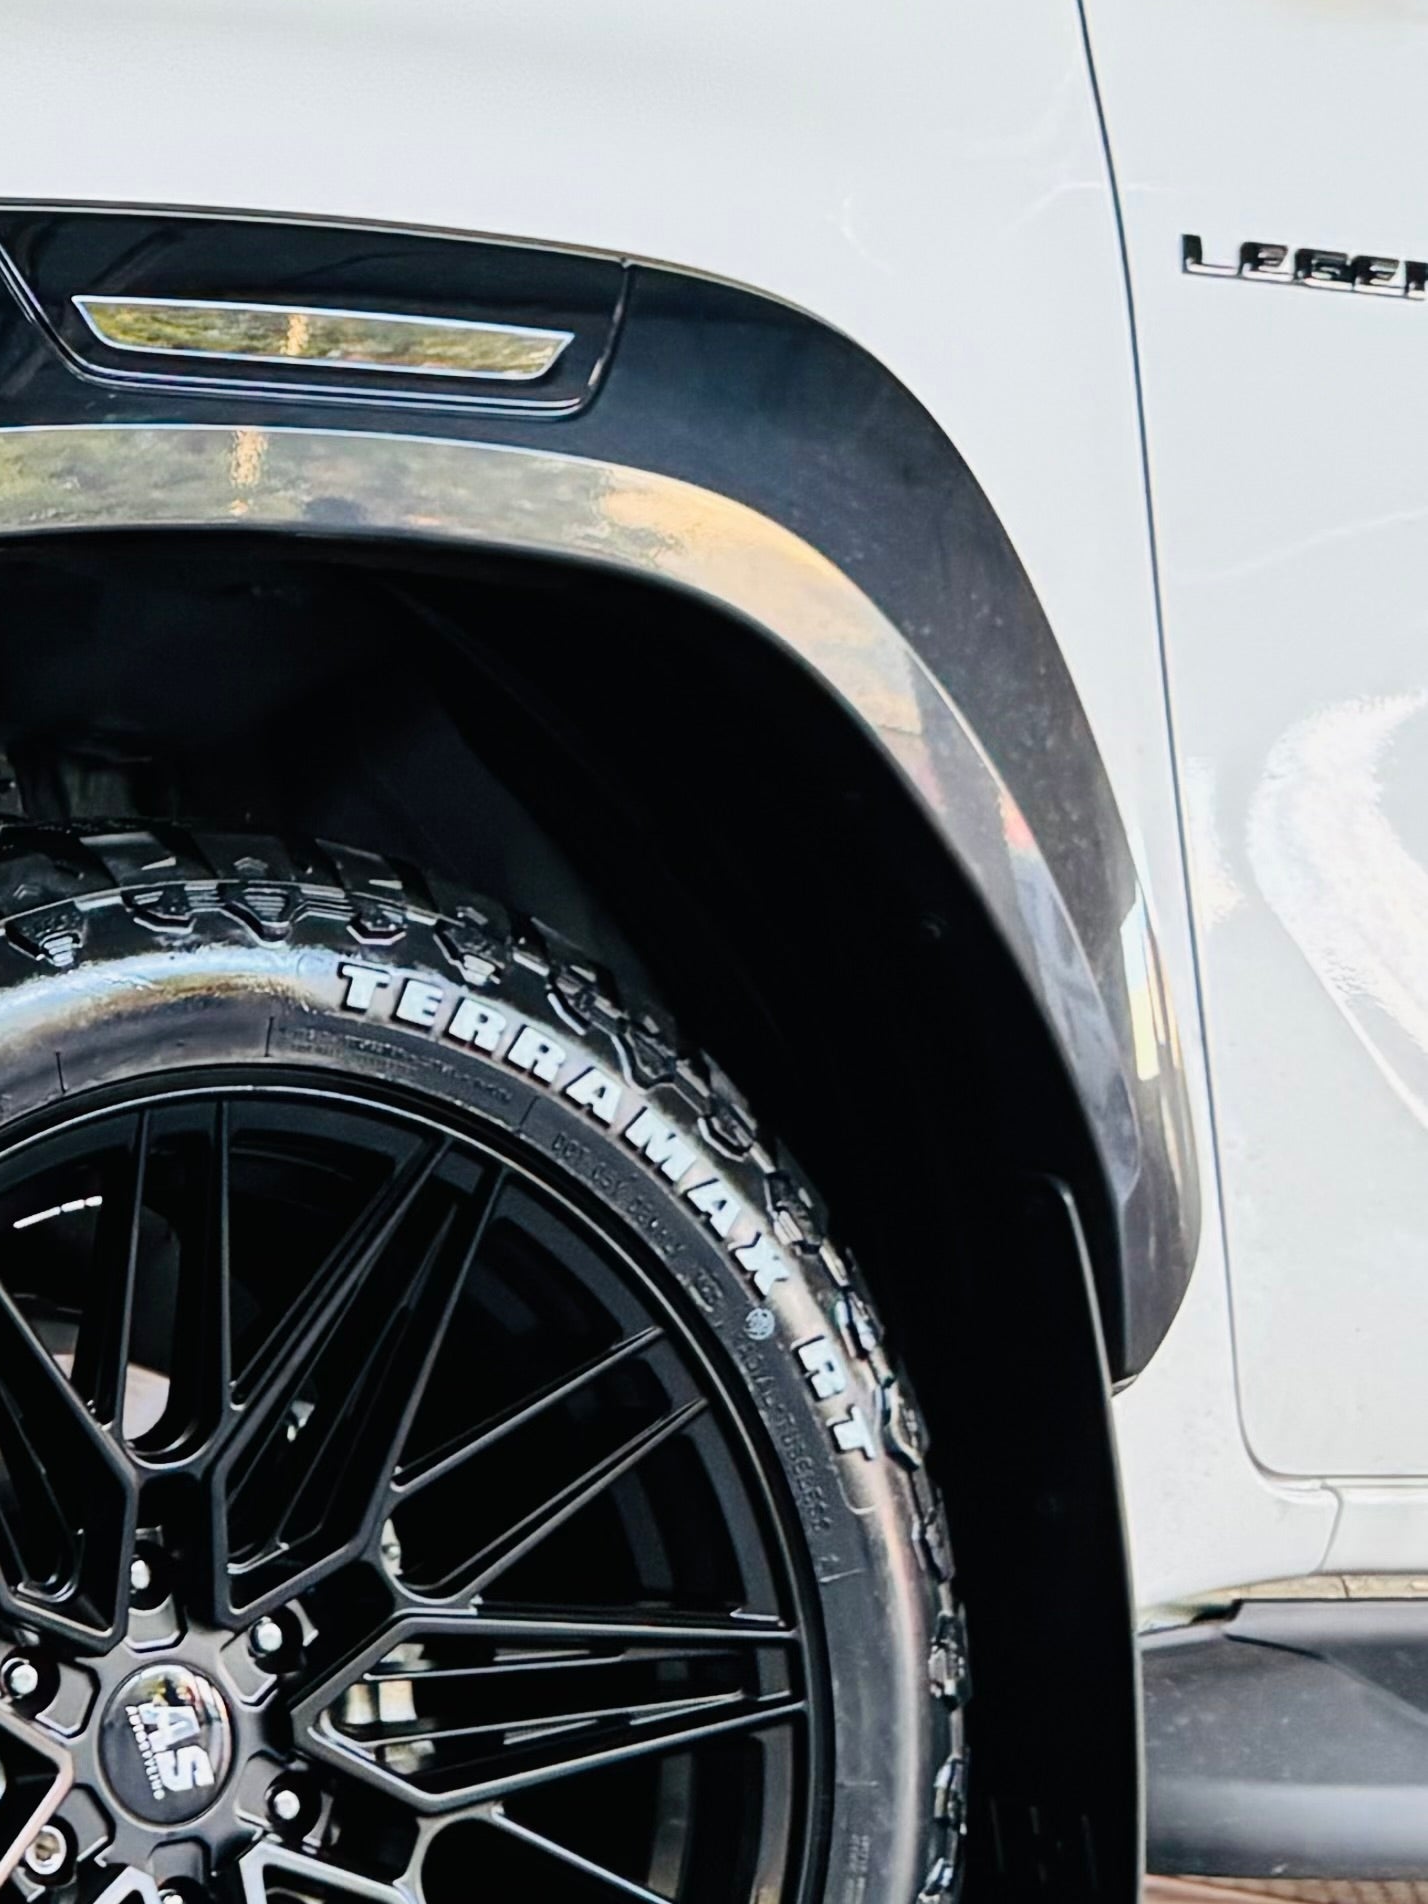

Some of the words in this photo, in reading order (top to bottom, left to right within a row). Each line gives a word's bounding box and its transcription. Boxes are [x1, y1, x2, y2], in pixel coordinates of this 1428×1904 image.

[339, 963, 791, 1297] TERRAMAX
[791, 1335, 876, 1462] RT
[138, 1702, 215, 1792] AS
